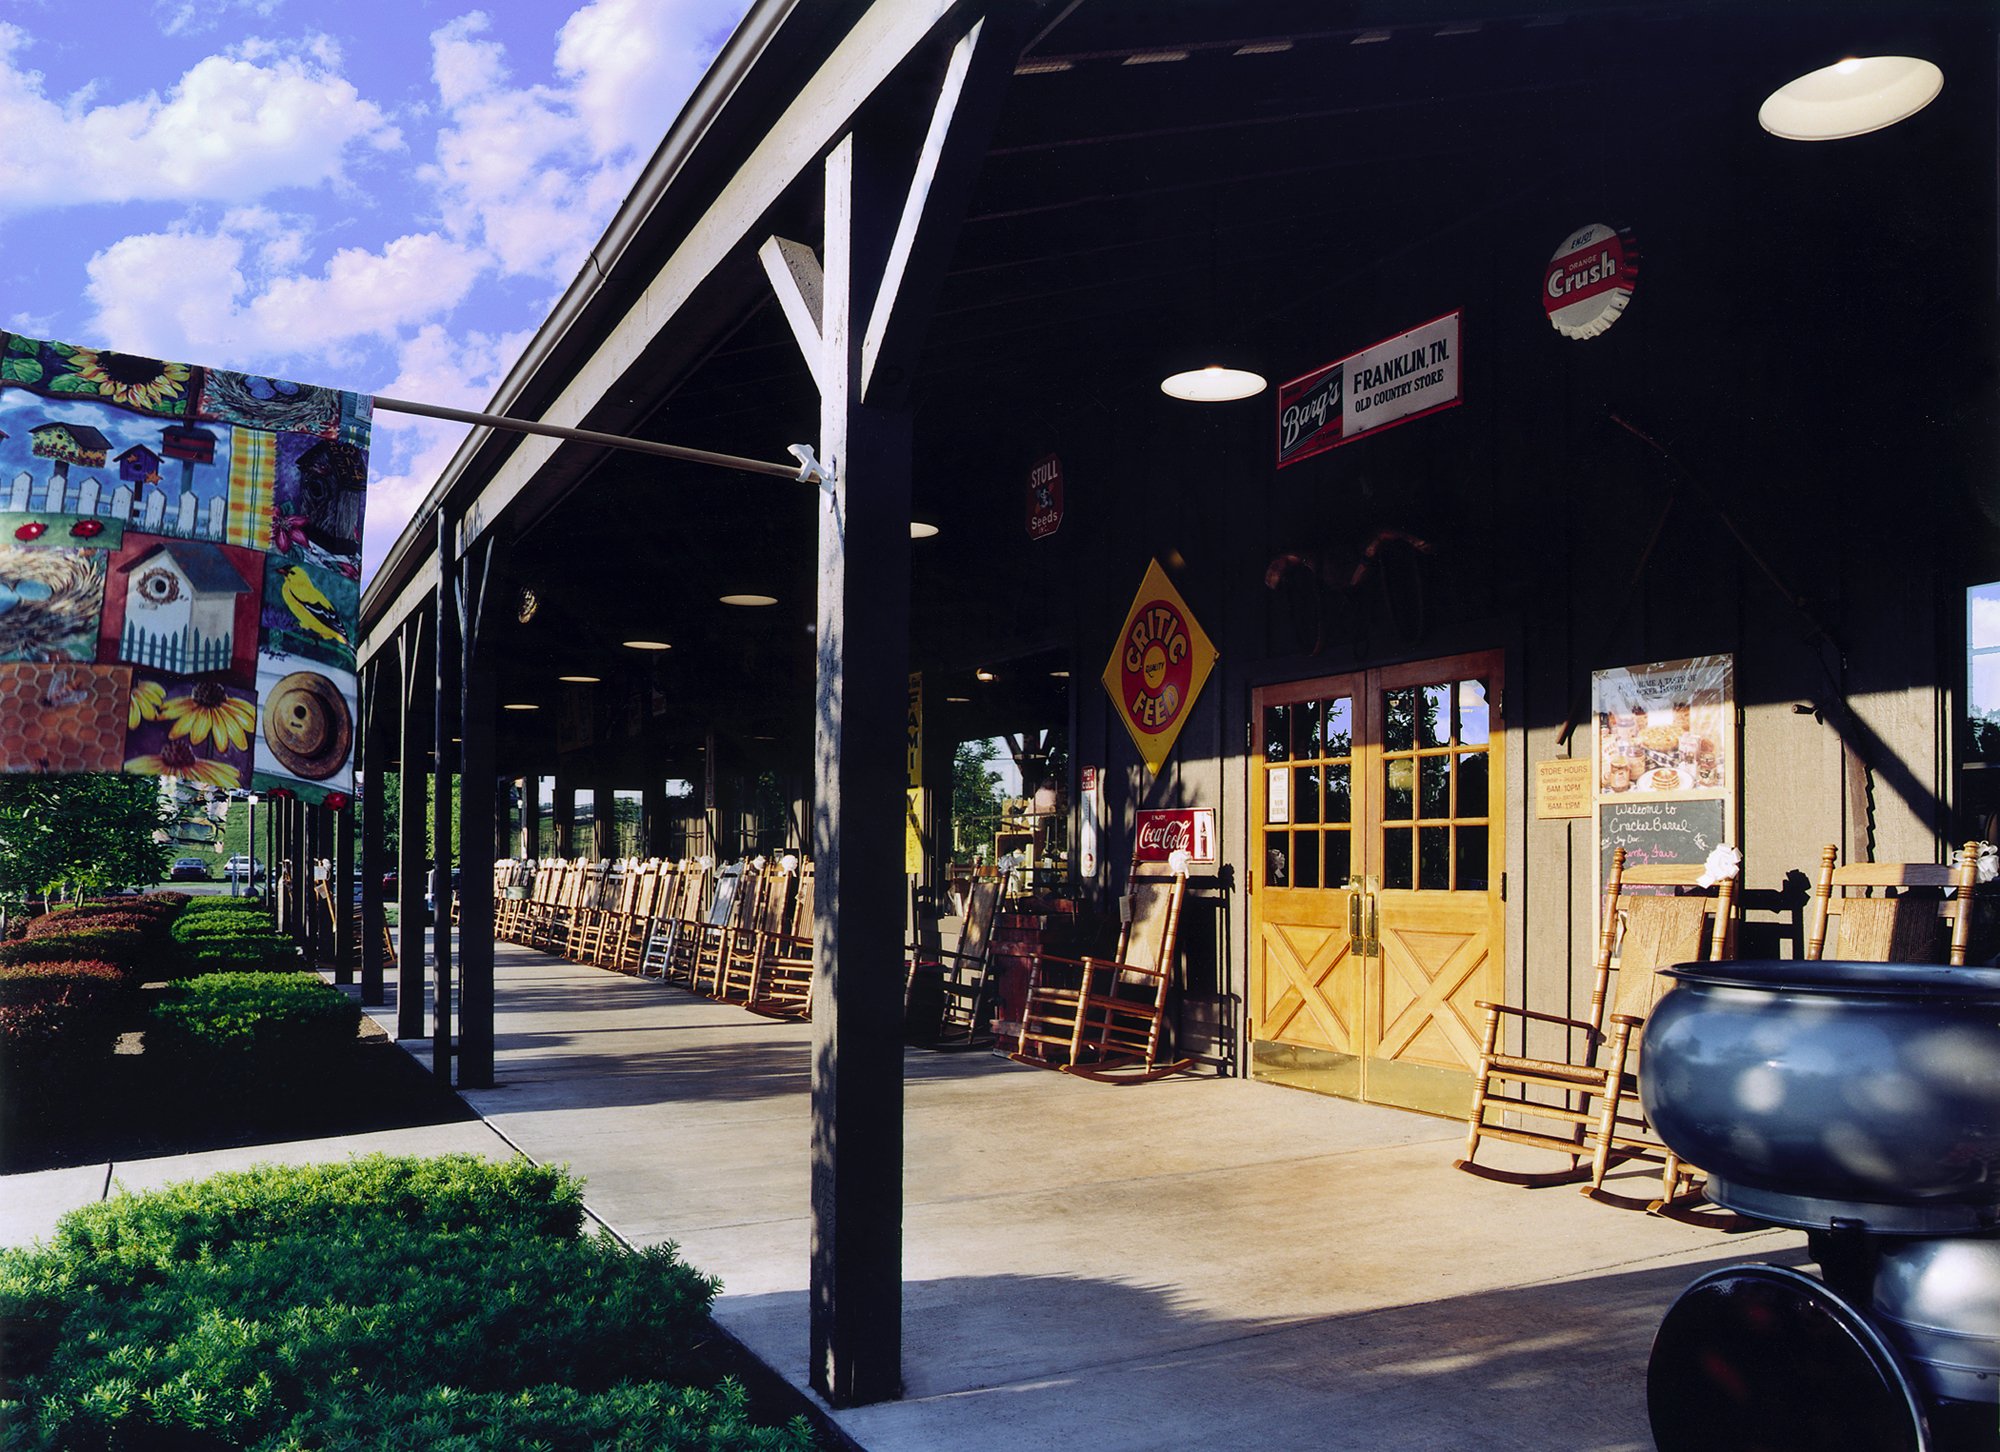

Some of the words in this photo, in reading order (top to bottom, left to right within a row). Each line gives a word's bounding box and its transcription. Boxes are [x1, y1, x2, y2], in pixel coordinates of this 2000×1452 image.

[1570, 228, 1595, 250] ENJOY
[1547, 250, 1616, 298] Crush
[1568, 254, 1598, 271] ORANGE
[1429, 338, 1450, 366] TN.
[1355, 396, 1372, 413] OLD
[1373, 380, 1413, 407] COUNTRY
[1413, 368, 1444, 392] STORE
[1282, 381, 1341, 449] Barq's
[1031, 460, 1058, 488] STULL
[1031, 509, 1058, 530] Seeds
[1126, 608, 1187, 673] CRITIC
[1132, 685, 1179, 726] FEED
[1540, 767, 1562, 776] STORE
[1564, 765, 1588, 773] HOURS
[1615, 804, 1662, 815] Welcome
[1665, 802, 1678, 815] to
[1139, 820, 1192, 850] Coca-Cola
[1609, 818, 1652, 833] Cracker
[1652, 817, 1691, 833] Barrel
